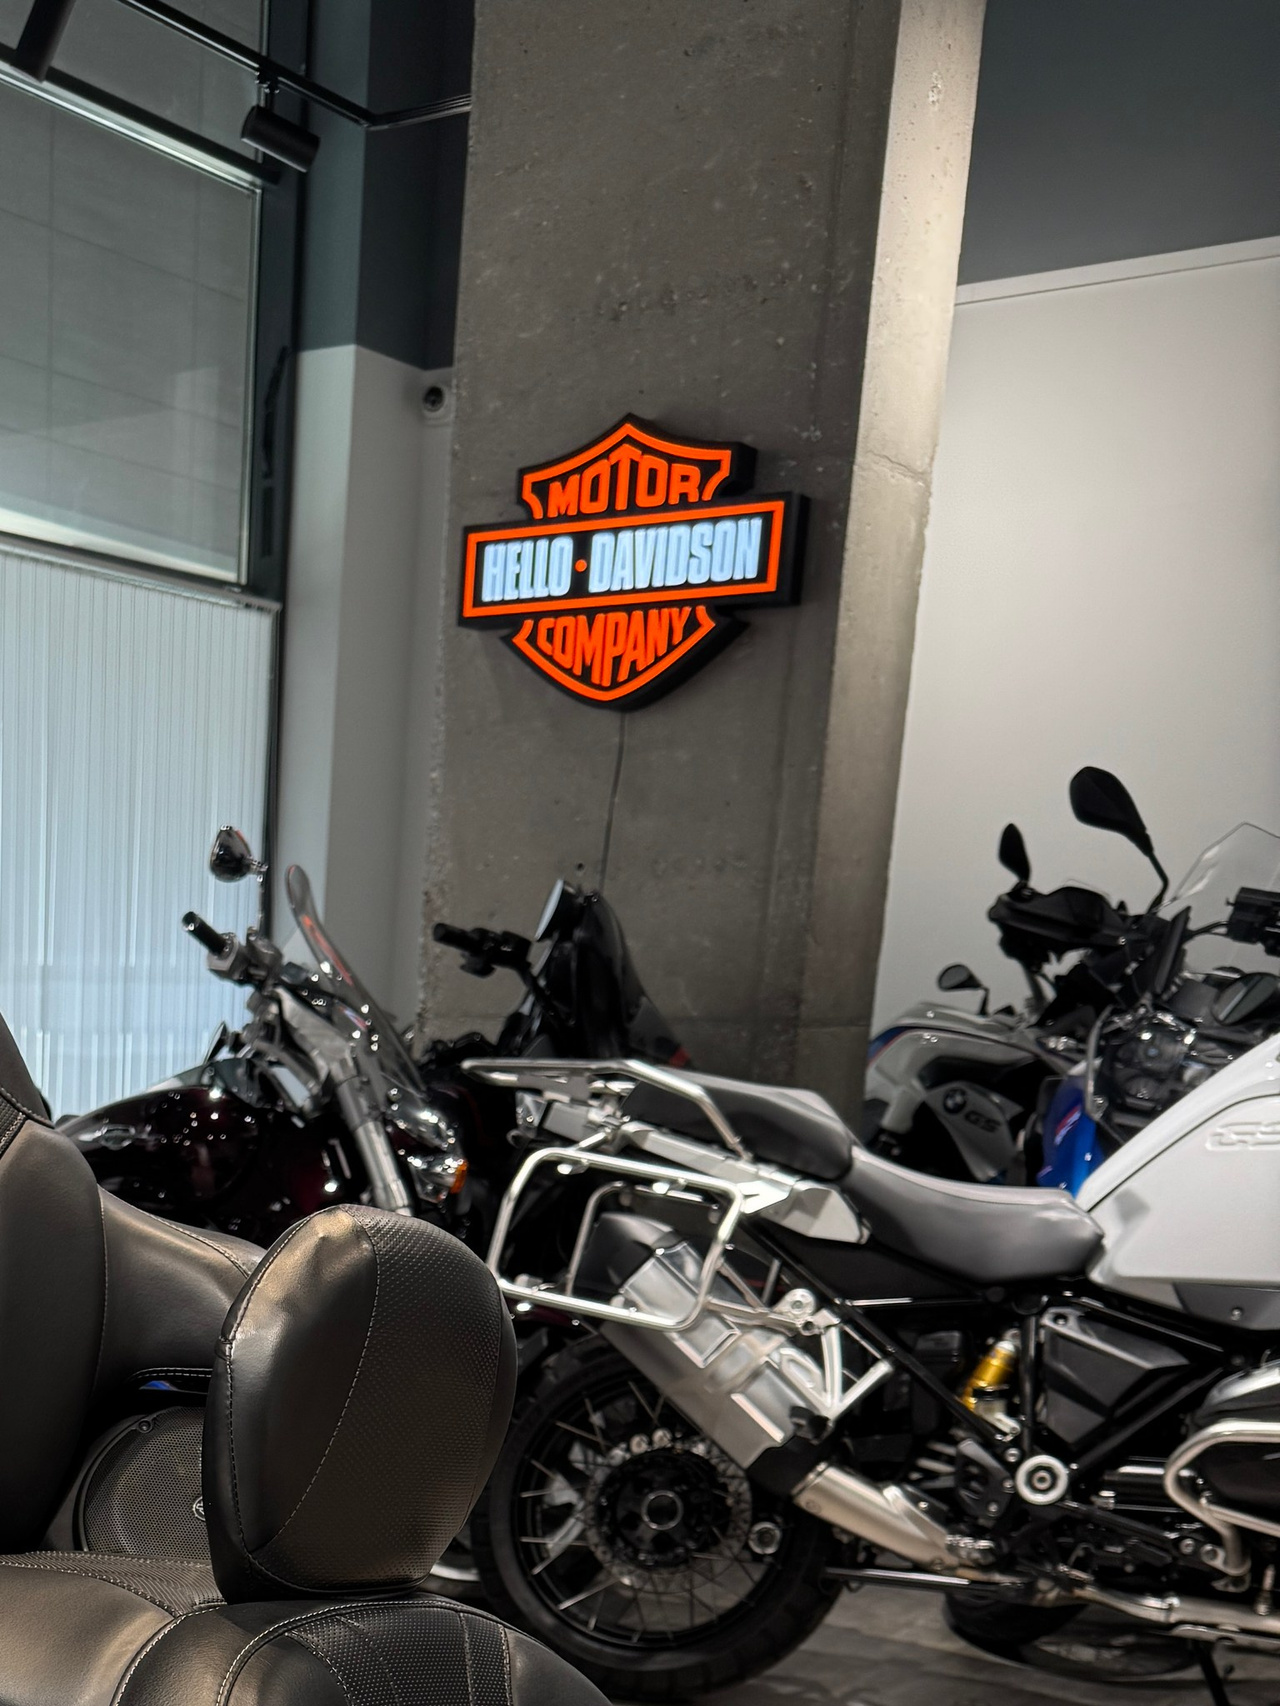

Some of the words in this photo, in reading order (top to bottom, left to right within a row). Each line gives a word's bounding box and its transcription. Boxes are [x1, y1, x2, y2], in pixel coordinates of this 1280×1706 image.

[547, 443, 700, 517] MOTOR
[482, 536, 573, 602] HELLO
[588, 517, 762, 593] DAVIDSON
[537, 606, 692, 687] COMPANY
[965, 1110, 1001, 1132] GS
